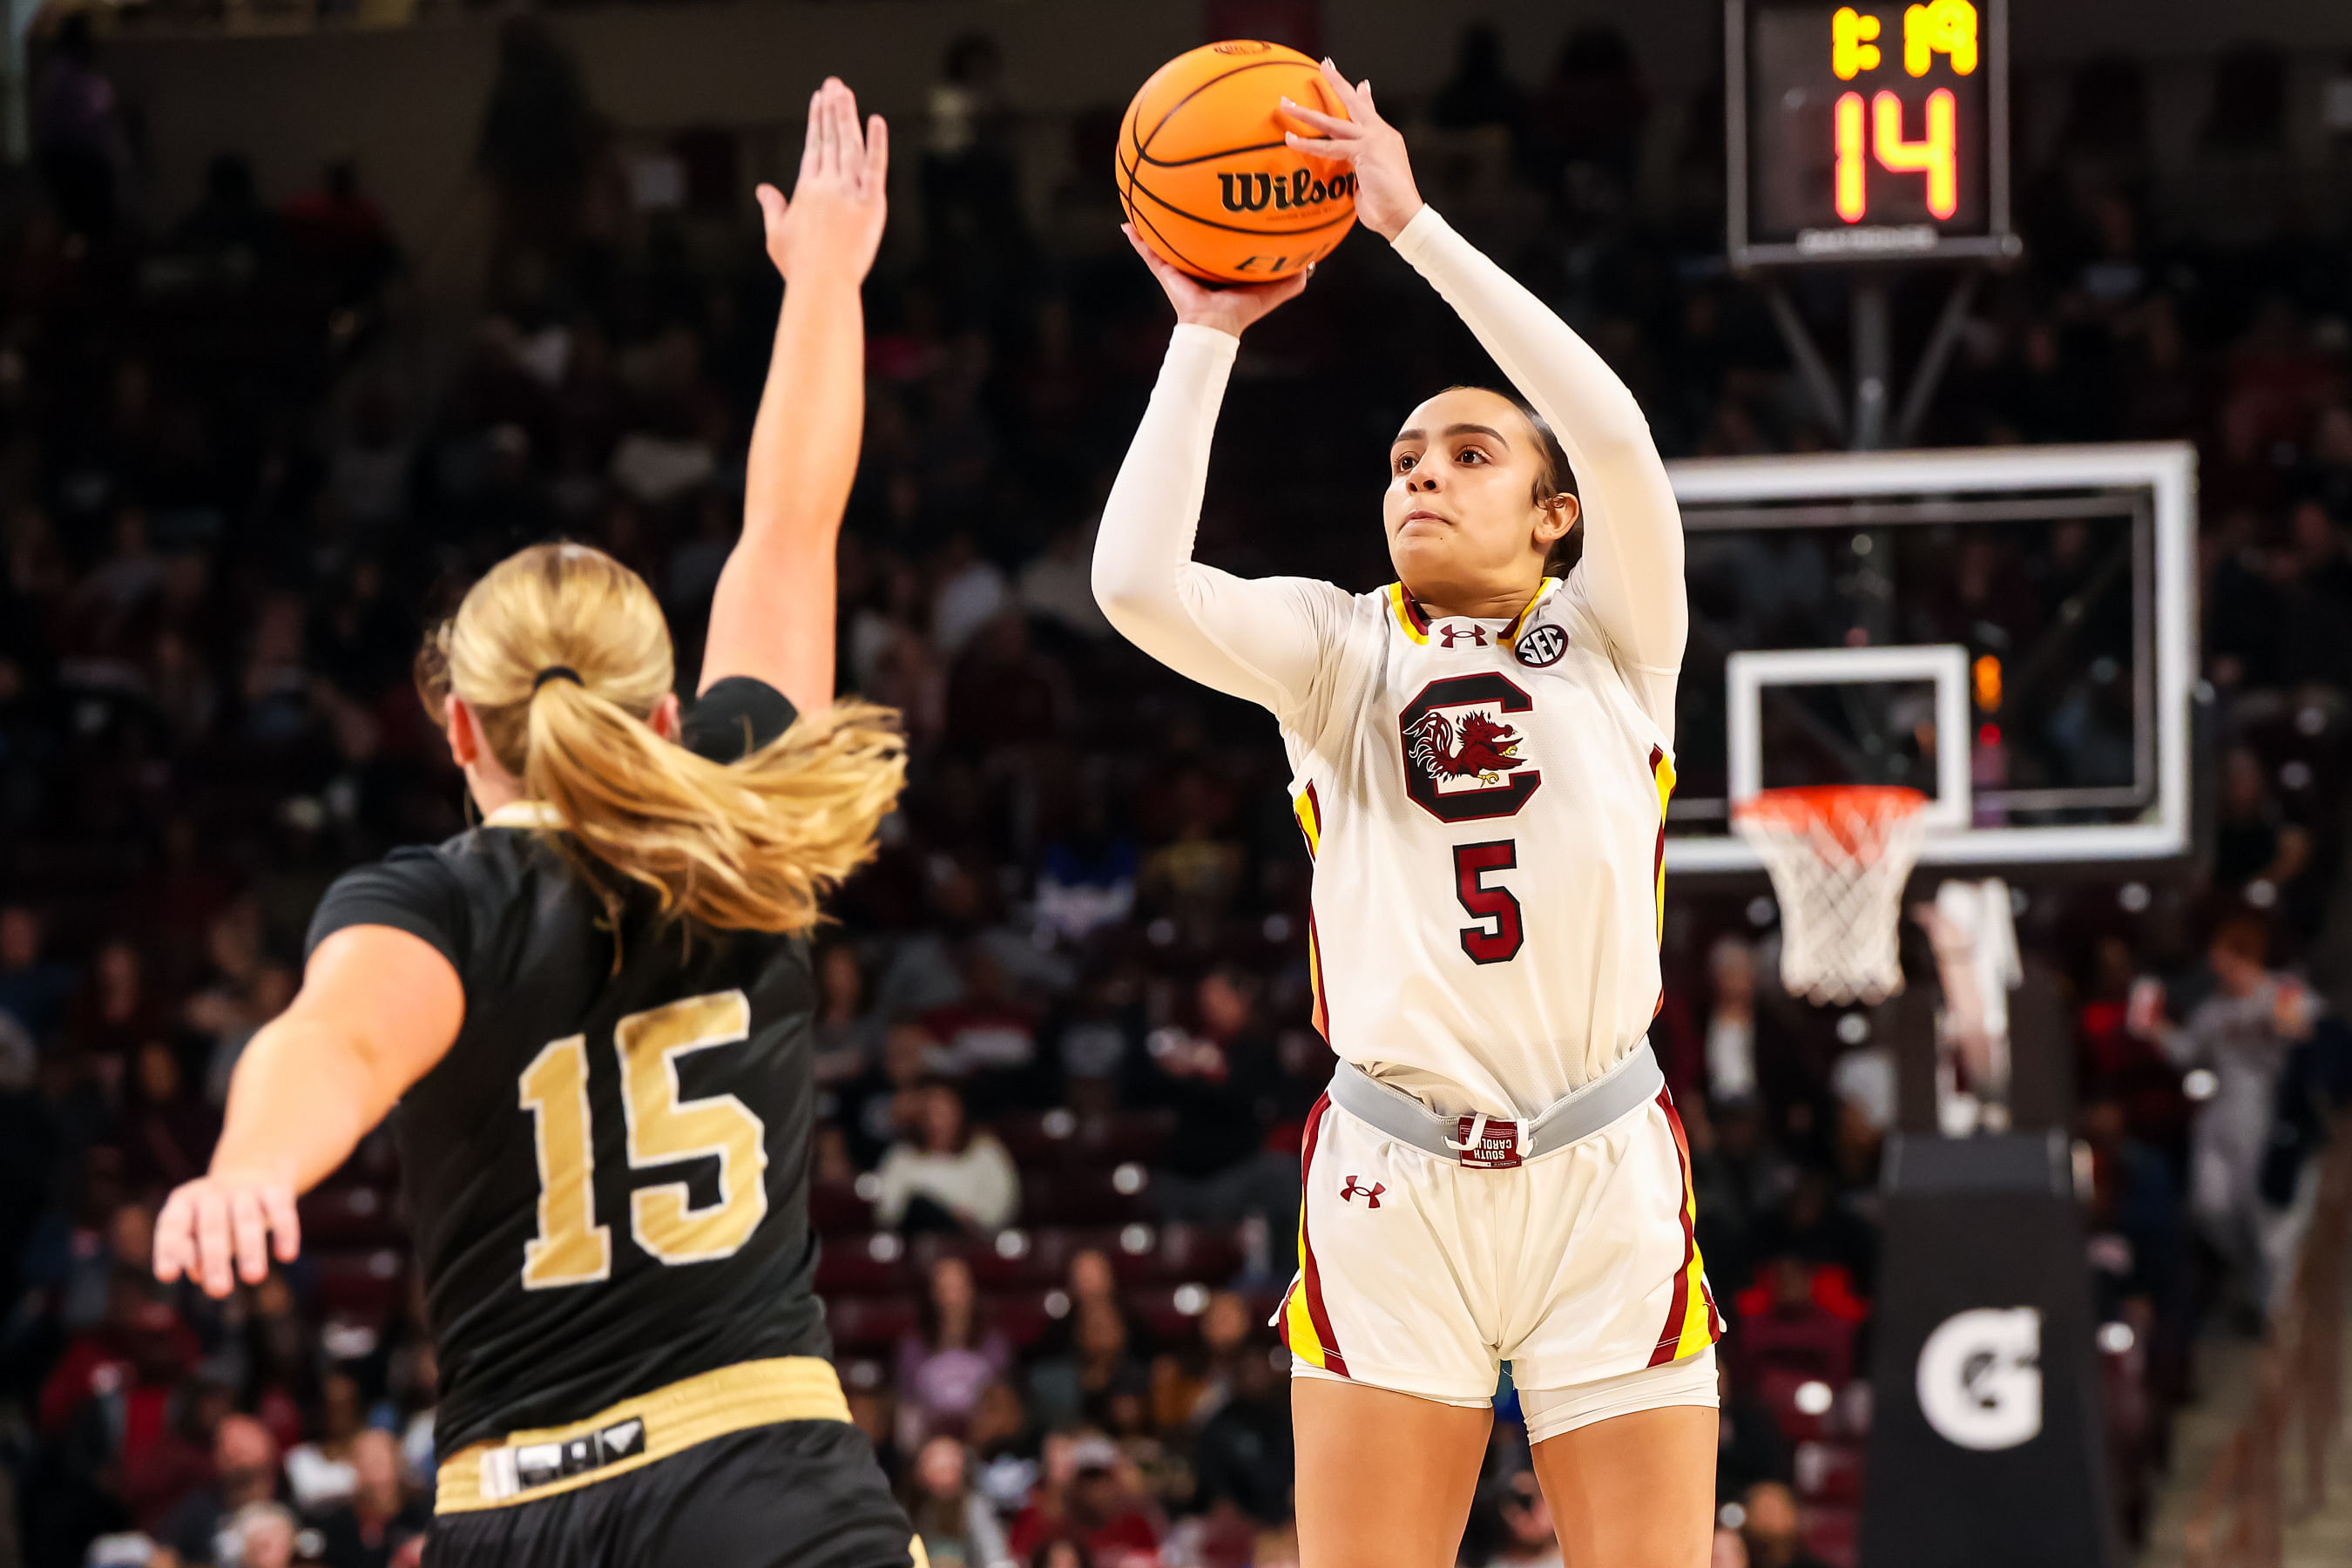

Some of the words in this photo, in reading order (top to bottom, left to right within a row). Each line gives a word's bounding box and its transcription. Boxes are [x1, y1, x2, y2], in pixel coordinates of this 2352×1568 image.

[1835, 88, 1957, 224] 14
[1518, 627, 1564, 665] SEC
[1452, 839, 1524, 965] 5
[518, 988, 768, 1291] 15
[1474, 1150, 1505, 1159] SOUTH
[1915, 1306, 2044, 1450] G
